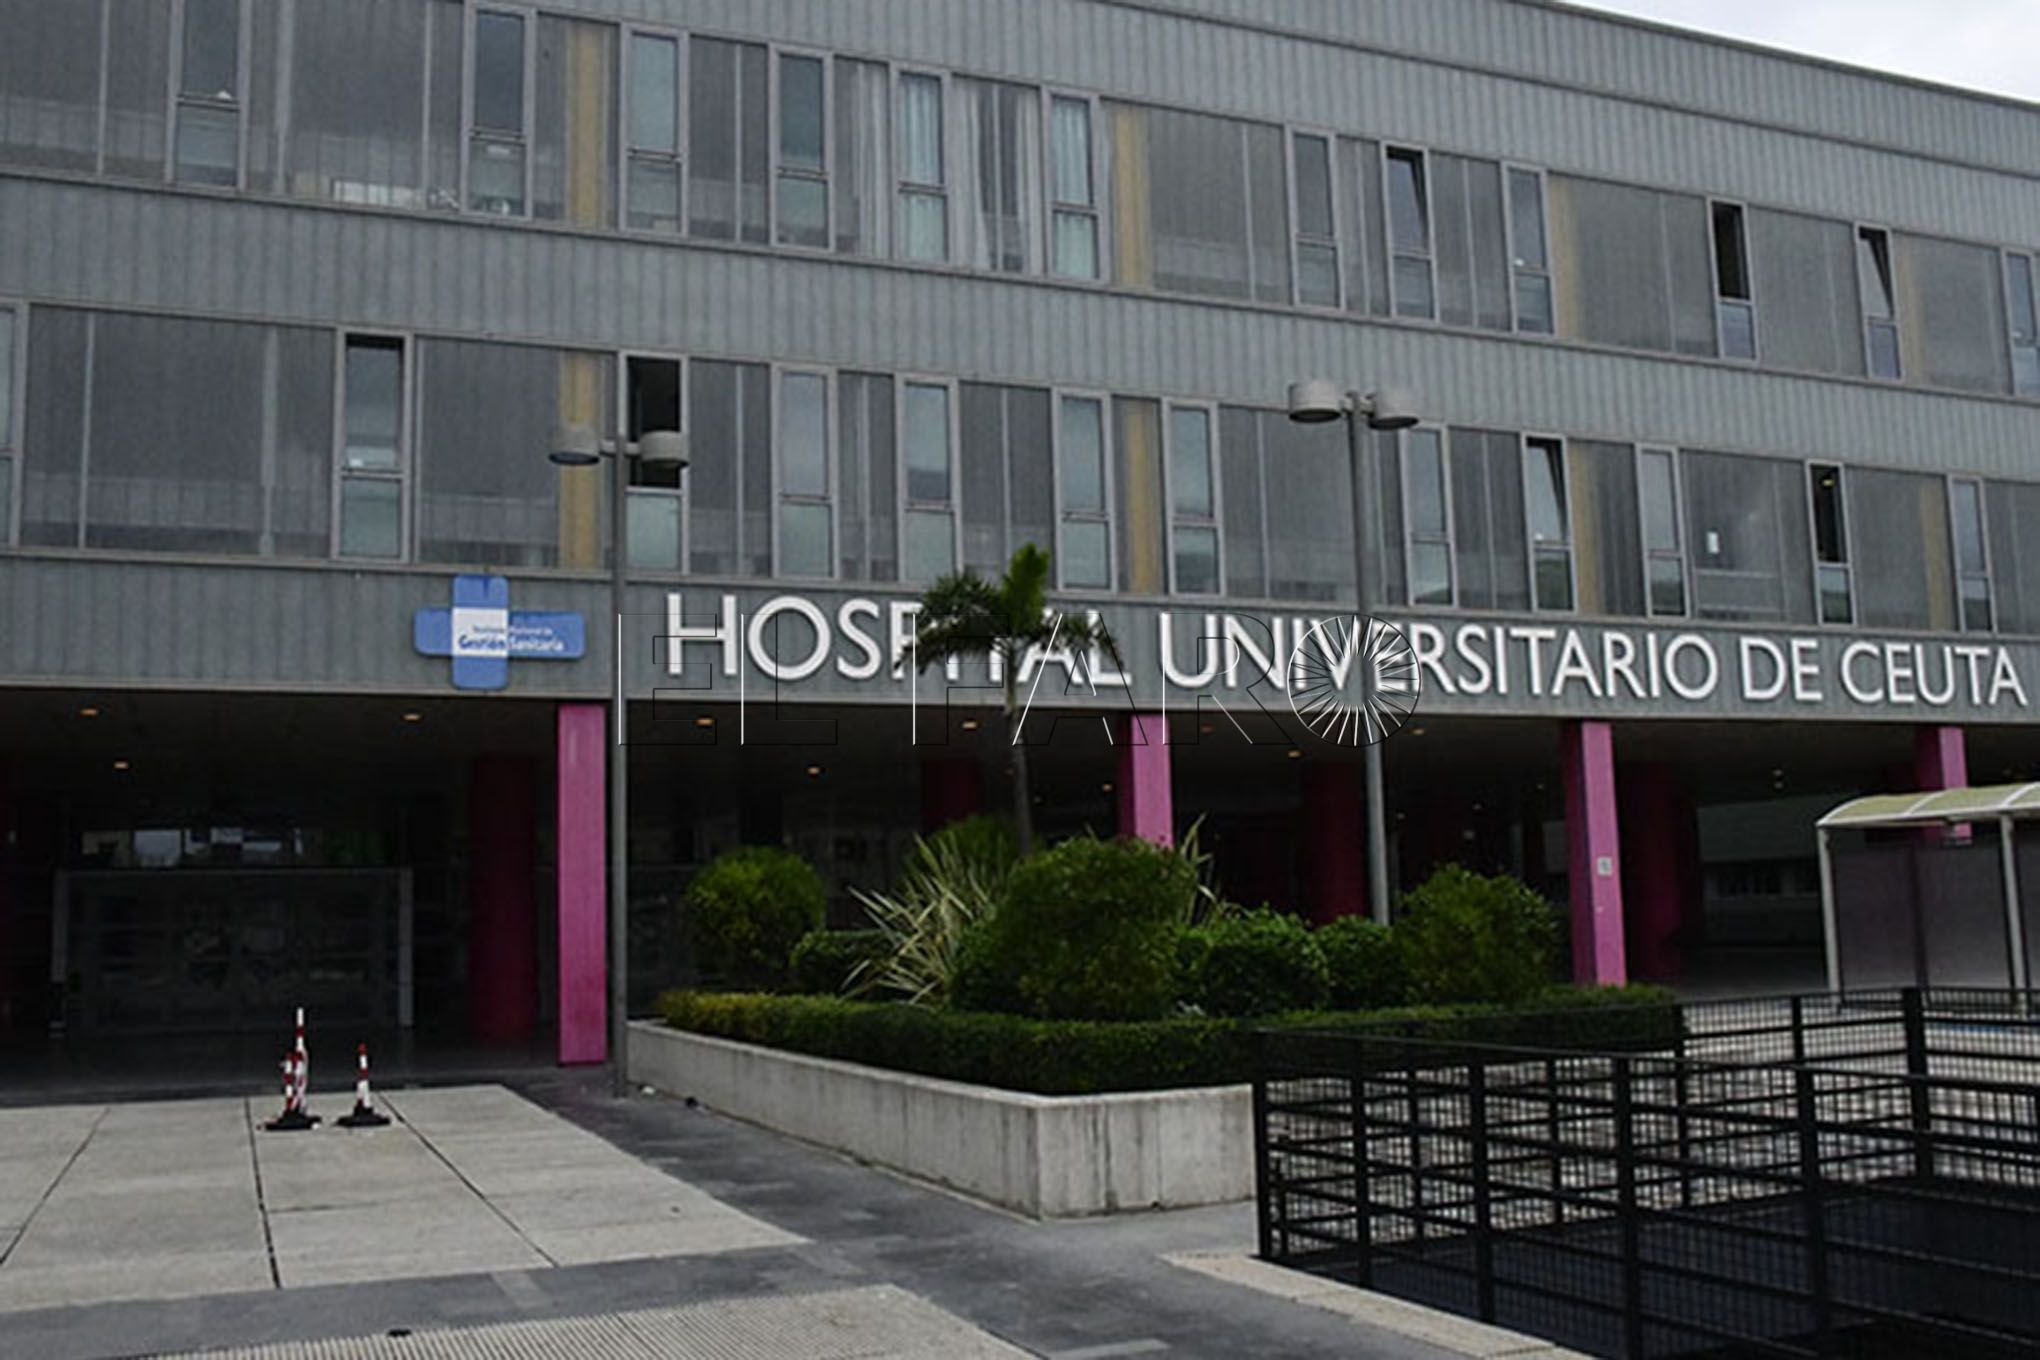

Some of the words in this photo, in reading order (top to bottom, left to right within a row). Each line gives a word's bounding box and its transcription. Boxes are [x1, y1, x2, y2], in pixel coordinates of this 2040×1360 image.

[1160, 612, 1719, 700] UNIVERSITARIO
[1740, 637, 1822, 700] DE
[1840, 643, 2029, 705] CEUTA
